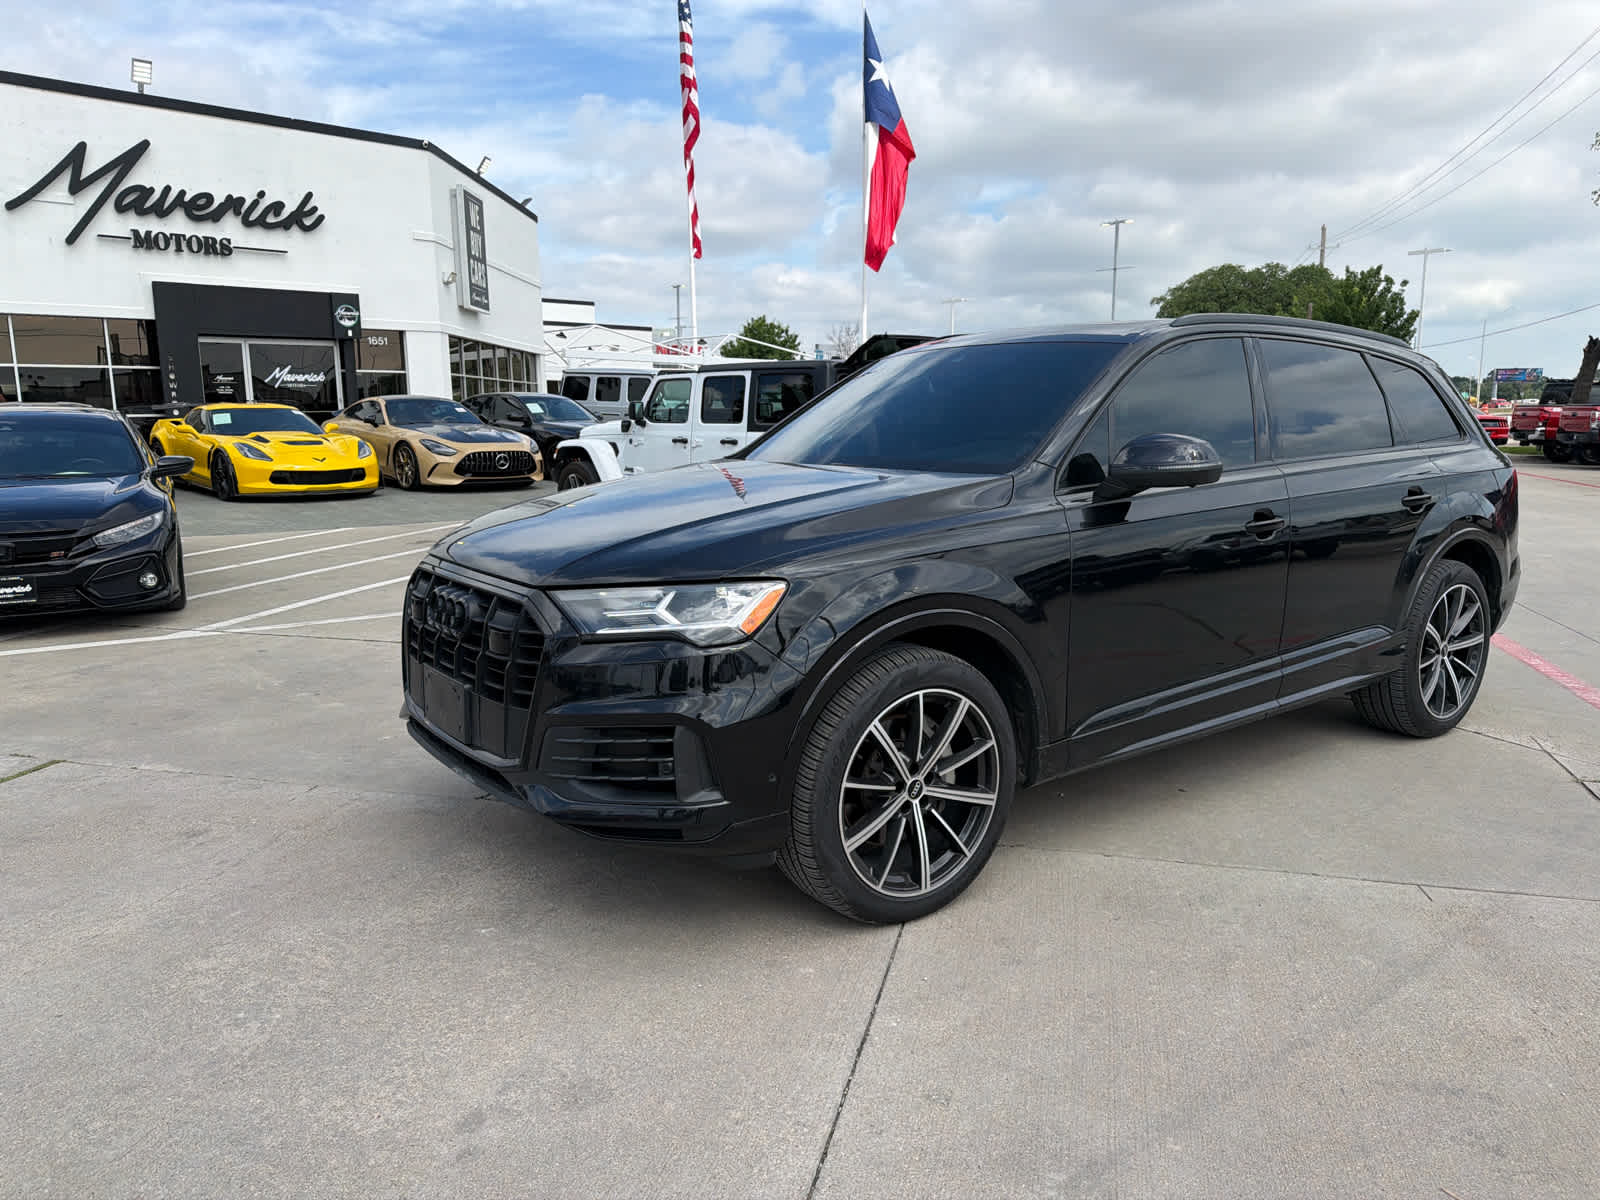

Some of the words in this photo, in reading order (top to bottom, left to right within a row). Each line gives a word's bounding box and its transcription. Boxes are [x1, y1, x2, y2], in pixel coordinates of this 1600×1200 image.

[5, 138, 326, 246] Maverick
[130, 228, 233, 257] MOTORS
[470, 258, 487, 289] CARS
[367, 335, 388, 346] 1651
[167, 352, 180, 417] SHOWRO
[264, 364, 326, 389] Maverick
